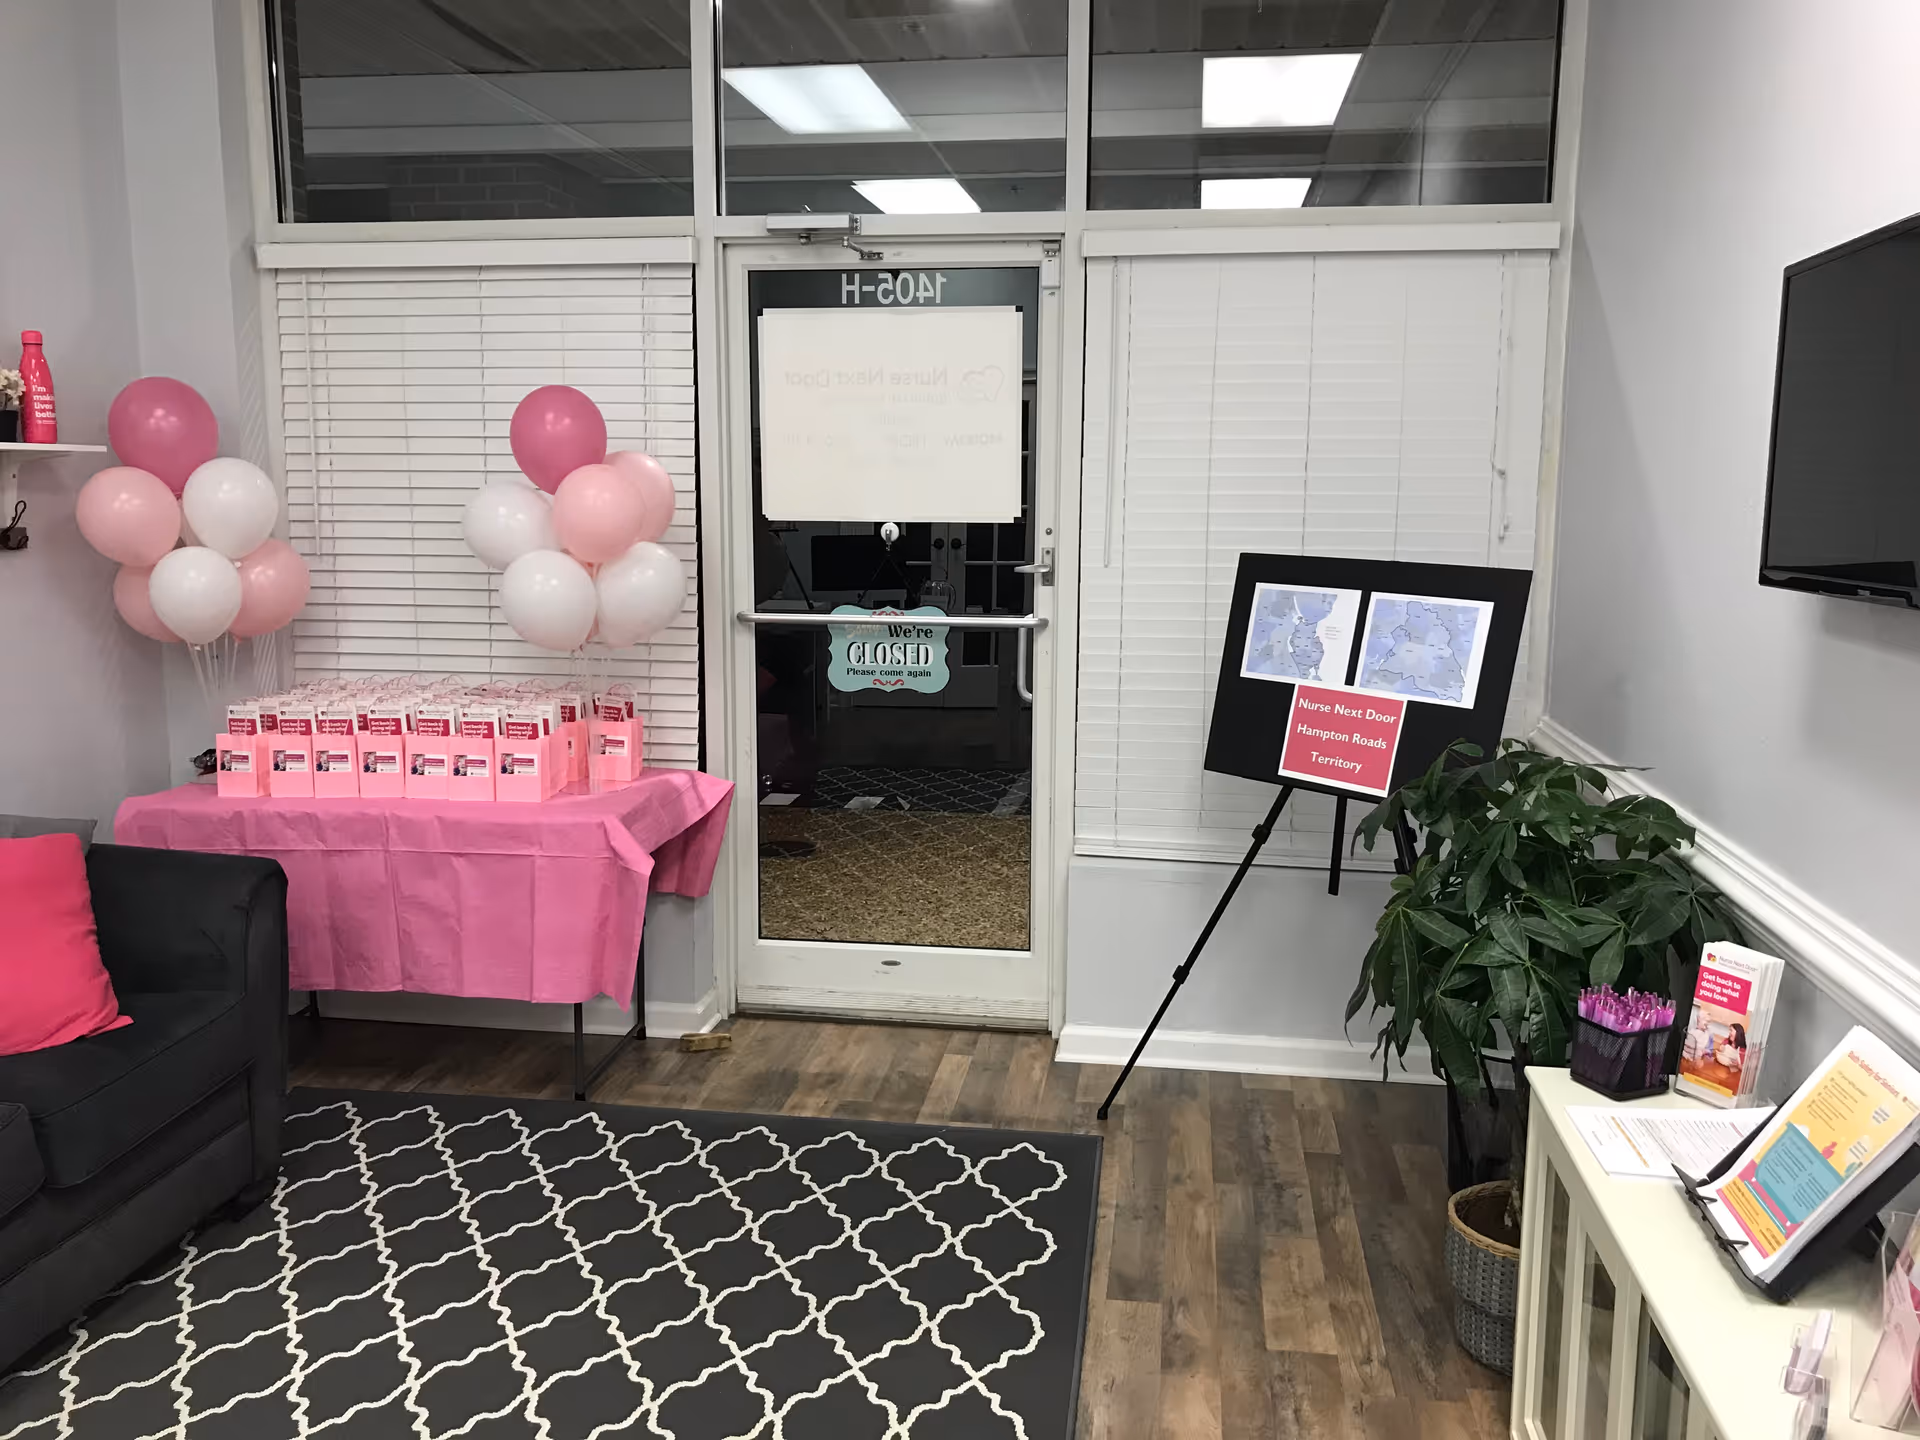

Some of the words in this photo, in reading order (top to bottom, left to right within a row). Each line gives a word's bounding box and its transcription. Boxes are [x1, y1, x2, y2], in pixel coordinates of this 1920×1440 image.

[32, 384, 46, 392] I'm
[887, 624, 933, 639] We're
[847, 641, 934, 667] CLOSED
[846, 667, 876, 677] Please
[879, 669, 904, 677] come
[907, 669, 932, 678] again
[1298, 697, 1332, 713] Nurse
[1334, 703, 1363, 718] Next
[1365, 708, 1397, 724] Door
[1297, 722, 1349, 742] Hampton
[1352, 733, 1387, 749] Roads
[1311, 751, 1363, 774] Territory
[1702, 972, 1716, 982] Get
[1716, 976, 1733, 987] back
[1699, 989, 1712, 998] you
[1714, 992, 1728, 1003] love
[1701, 980, 1721, 993] doing
[1722, 988, 1740, 998] what
